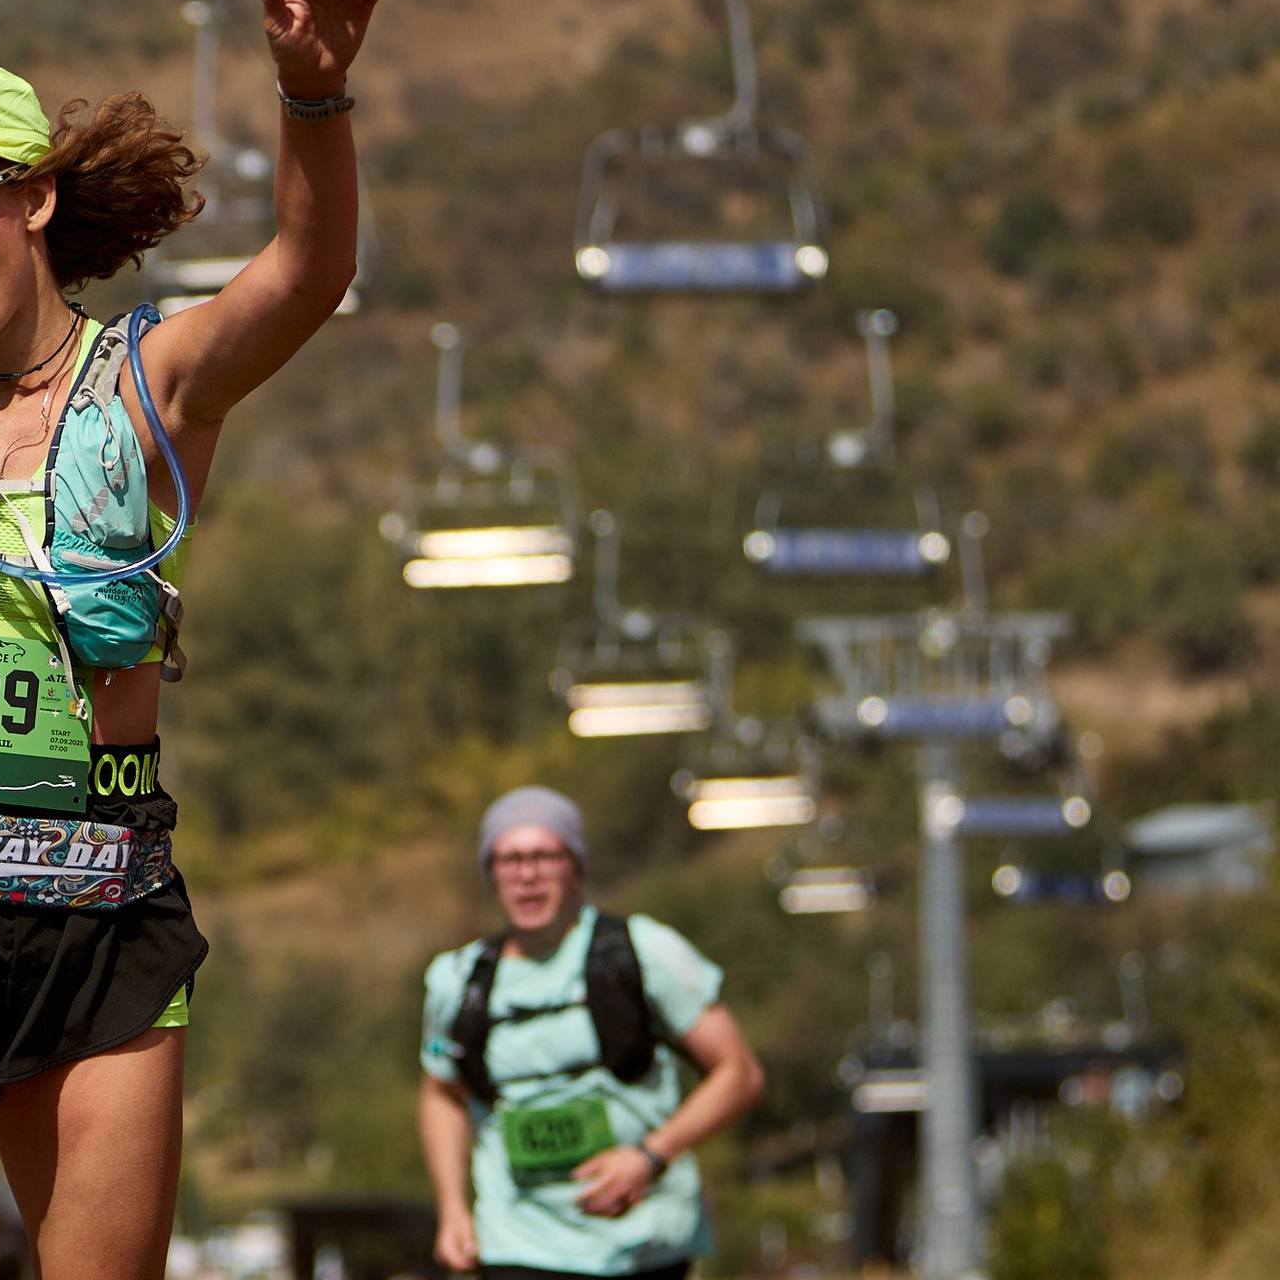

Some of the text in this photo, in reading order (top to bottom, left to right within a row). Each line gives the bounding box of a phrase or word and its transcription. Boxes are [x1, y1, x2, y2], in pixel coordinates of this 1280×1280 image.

[51, 729, 71, 737] START
[50, 737, 84, 747] 07.09.2025
[49, 745, 68, 753] 07:00
[87, 751, 158, 796] OOM
[63, 842, 133, 869] DAY
